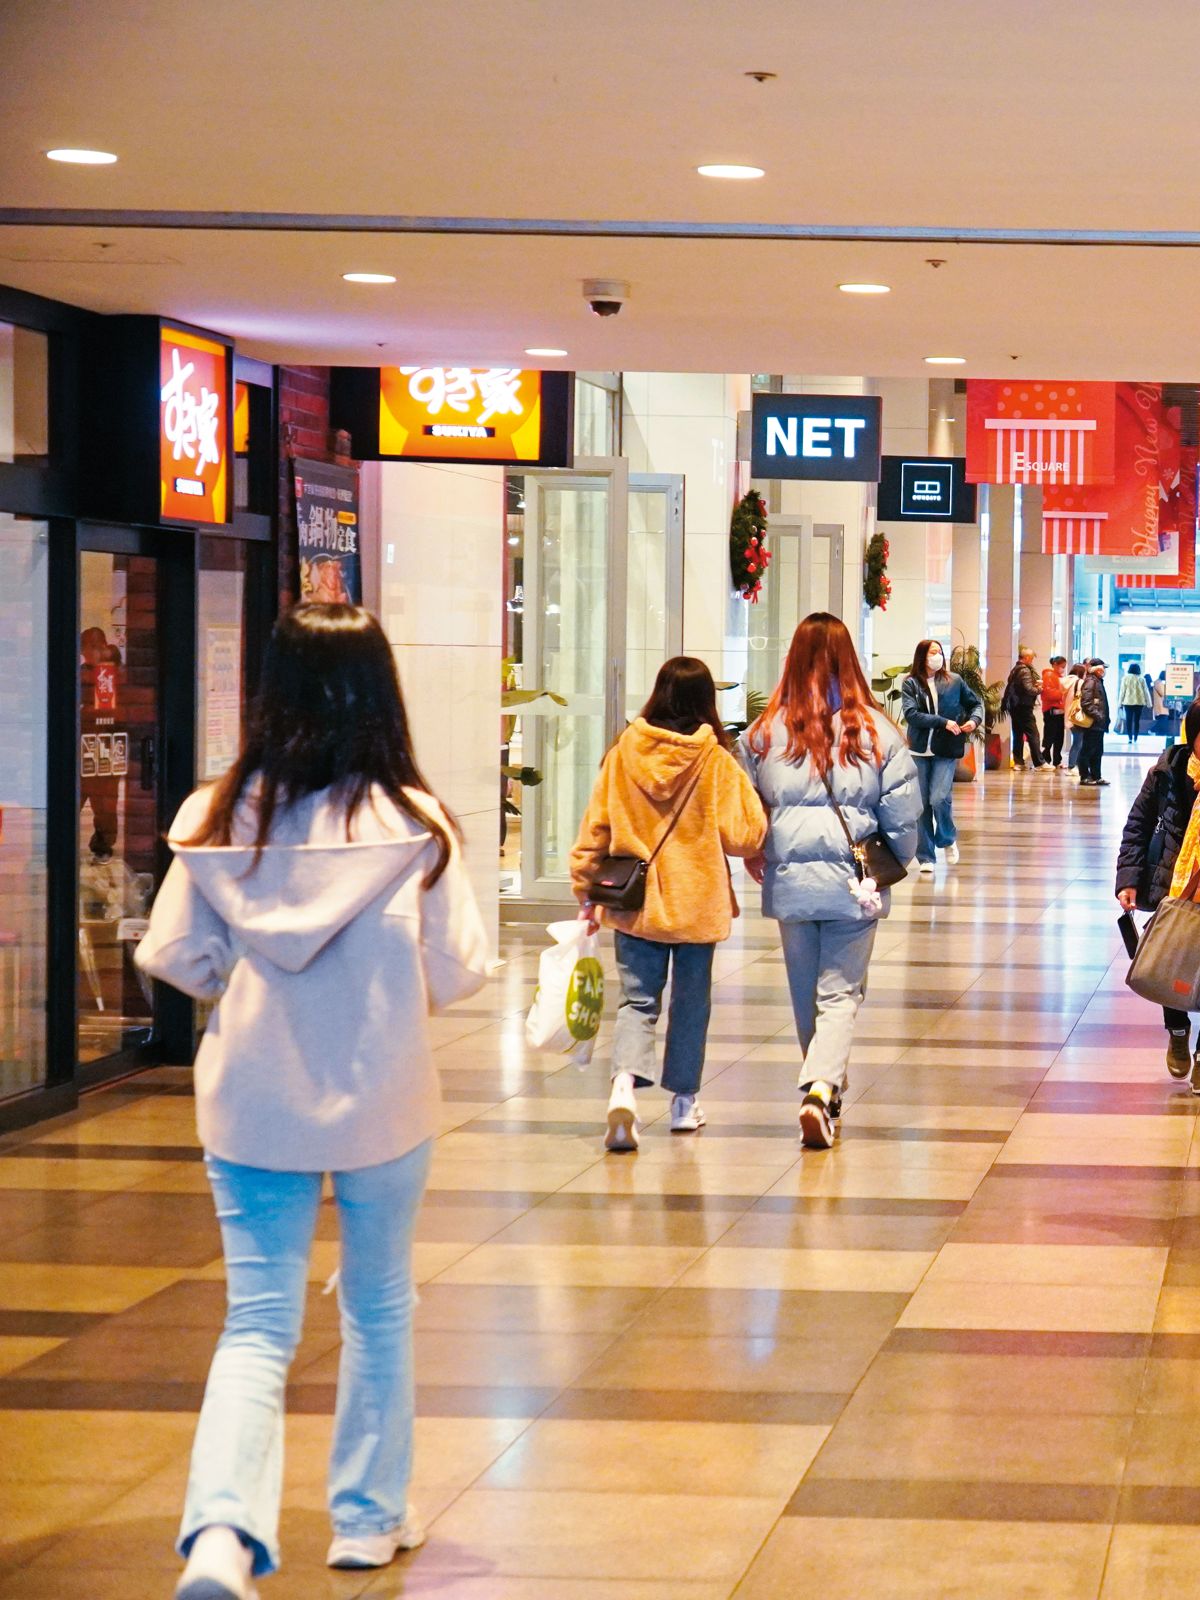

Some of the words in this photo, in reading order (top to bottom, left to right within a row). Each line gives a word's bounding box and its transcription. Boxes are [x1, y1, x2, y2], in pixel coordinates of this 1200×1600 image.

[766, 416, 866, 458] NET
[1134, 417, 1158, 476] New
[1131, 484, 1159, 556] Happy
